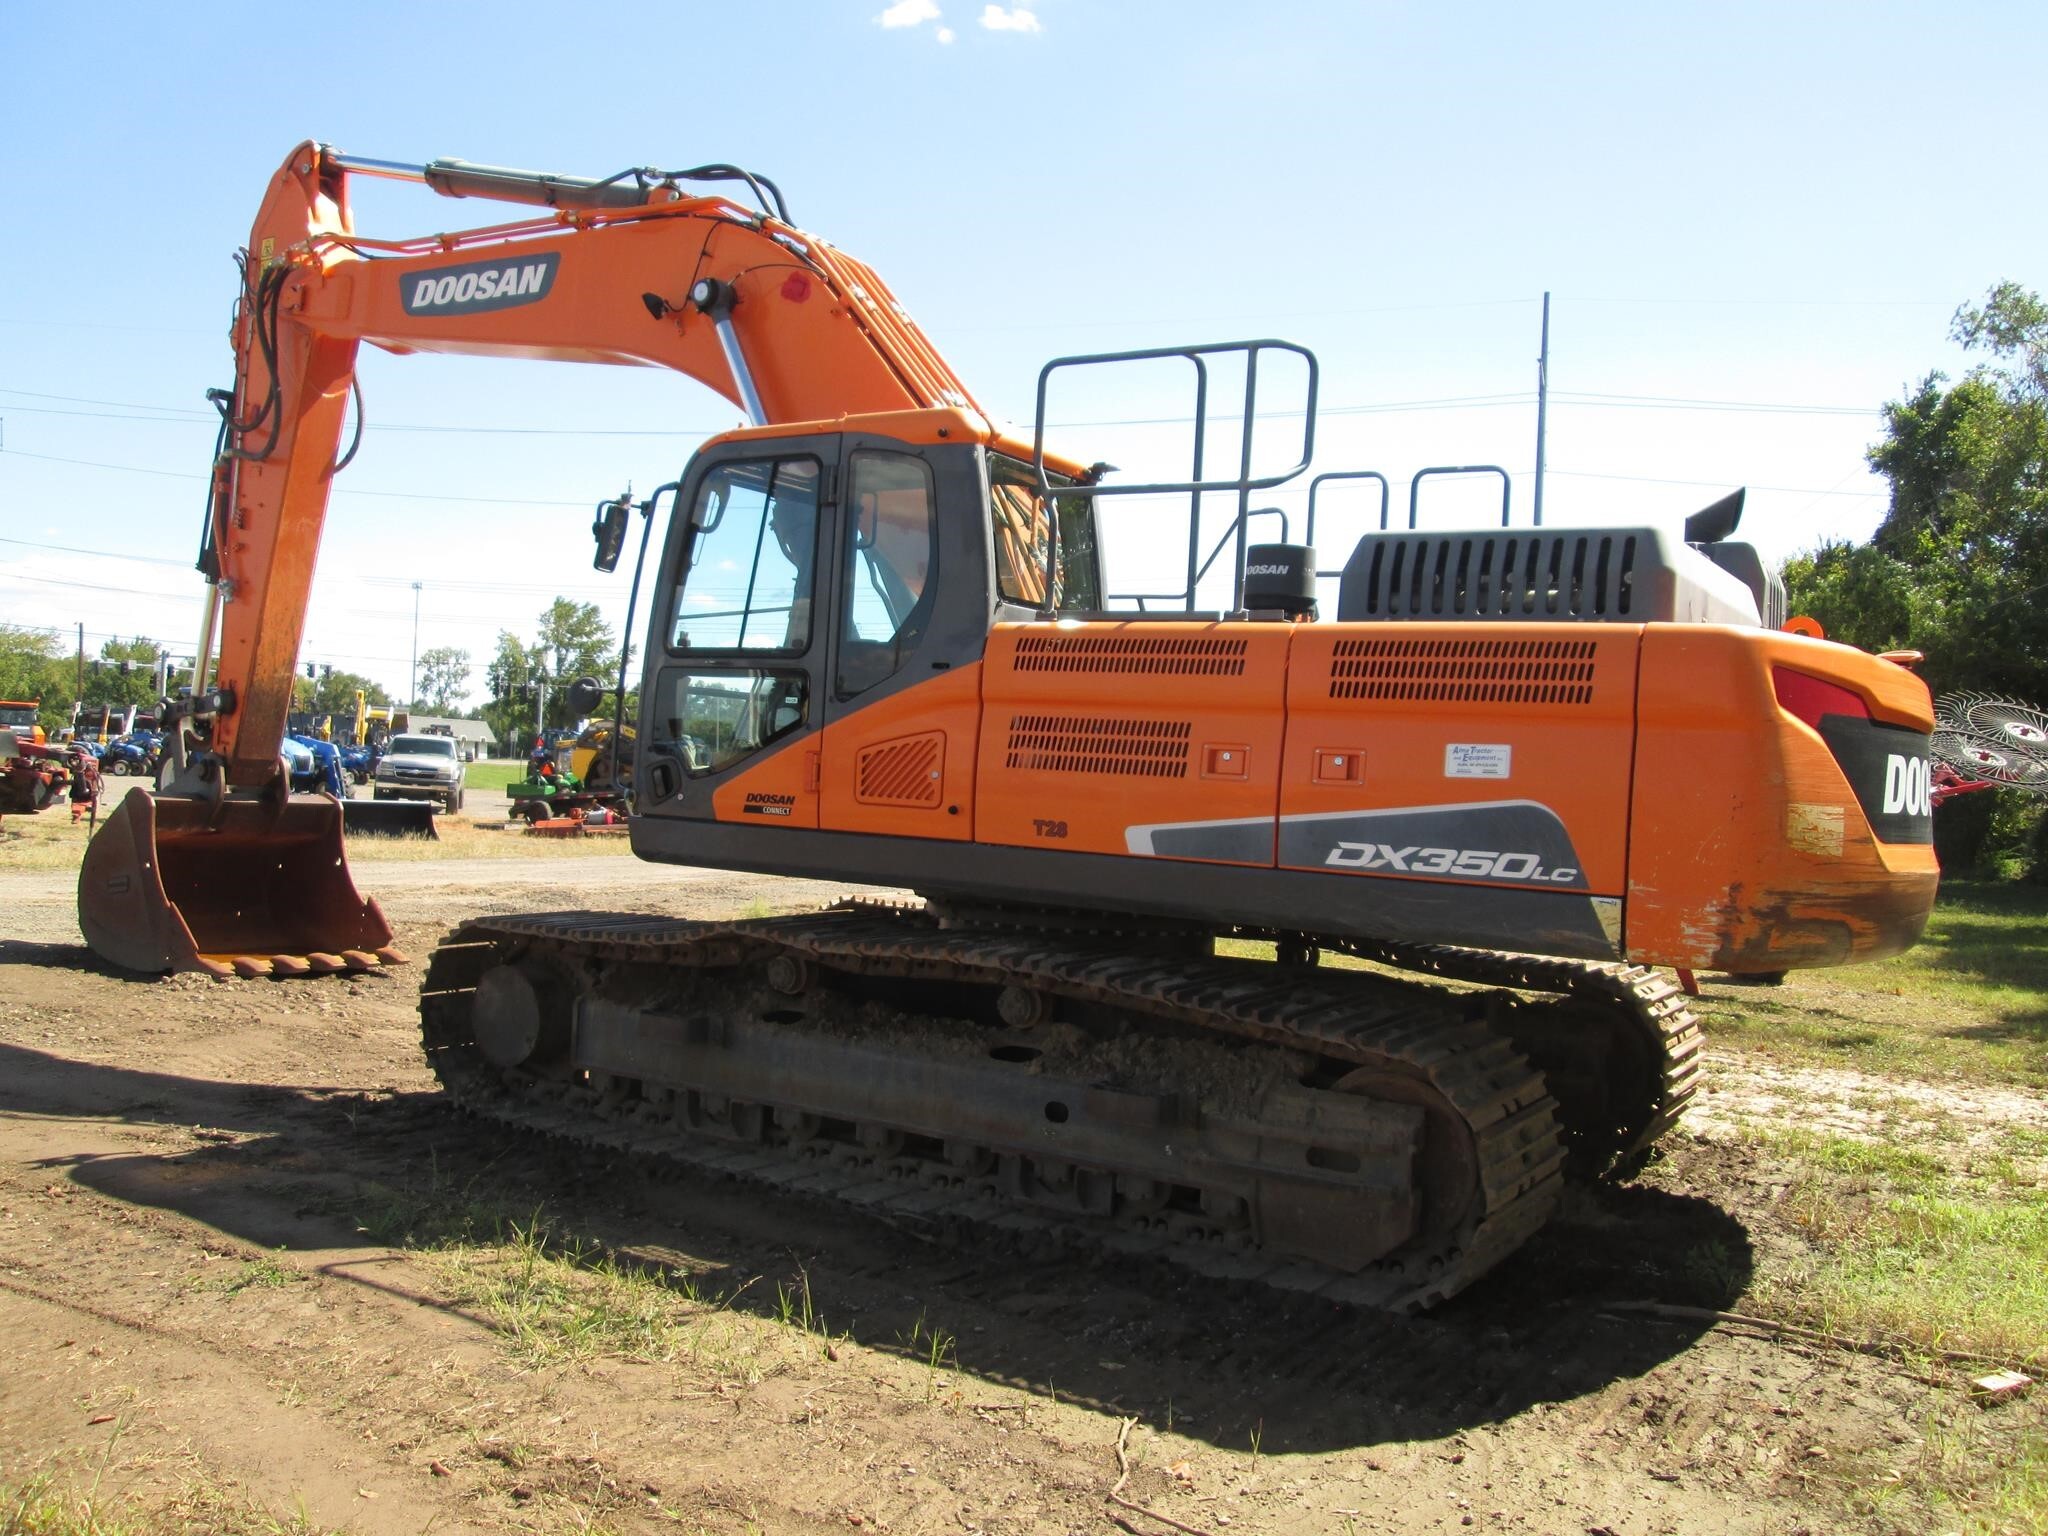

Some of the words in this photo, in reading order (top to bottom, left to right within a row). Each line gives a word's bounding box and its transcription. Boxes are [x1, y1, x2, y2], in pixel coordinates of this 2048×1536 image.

[411, 263, 547, 308] DOOSAN
[1246, 565, 1289, 575] OOSAN
[1470, 746, 1494, 755] Tractor
[1462, 754, 1497, 762] Equipment
[1883, 754, 1932, 816] DOO
[746, 793, 796, 805] DOOSAN
[762, 806, 790, 815] CONNECT
